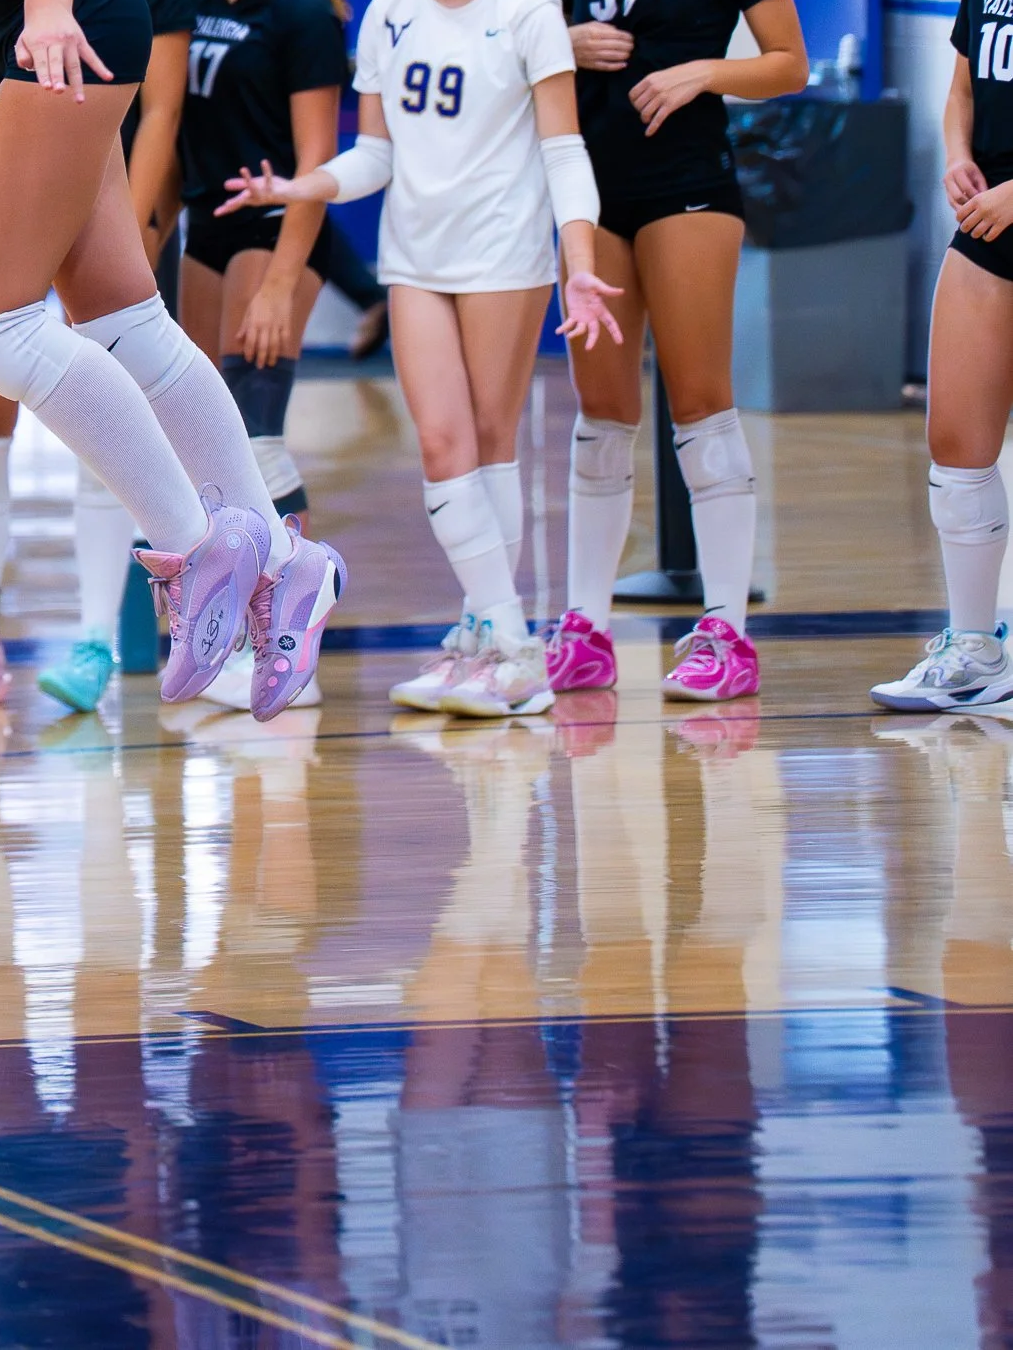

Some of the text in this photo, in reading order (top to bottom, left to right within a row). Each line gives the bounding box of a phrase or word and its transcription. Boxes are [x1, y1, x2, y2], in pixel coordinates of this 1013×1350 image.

[189, 40, 230, 99] 17
[978, 22, 1013, 82] 10
[401, 61, 465, 119] 99
